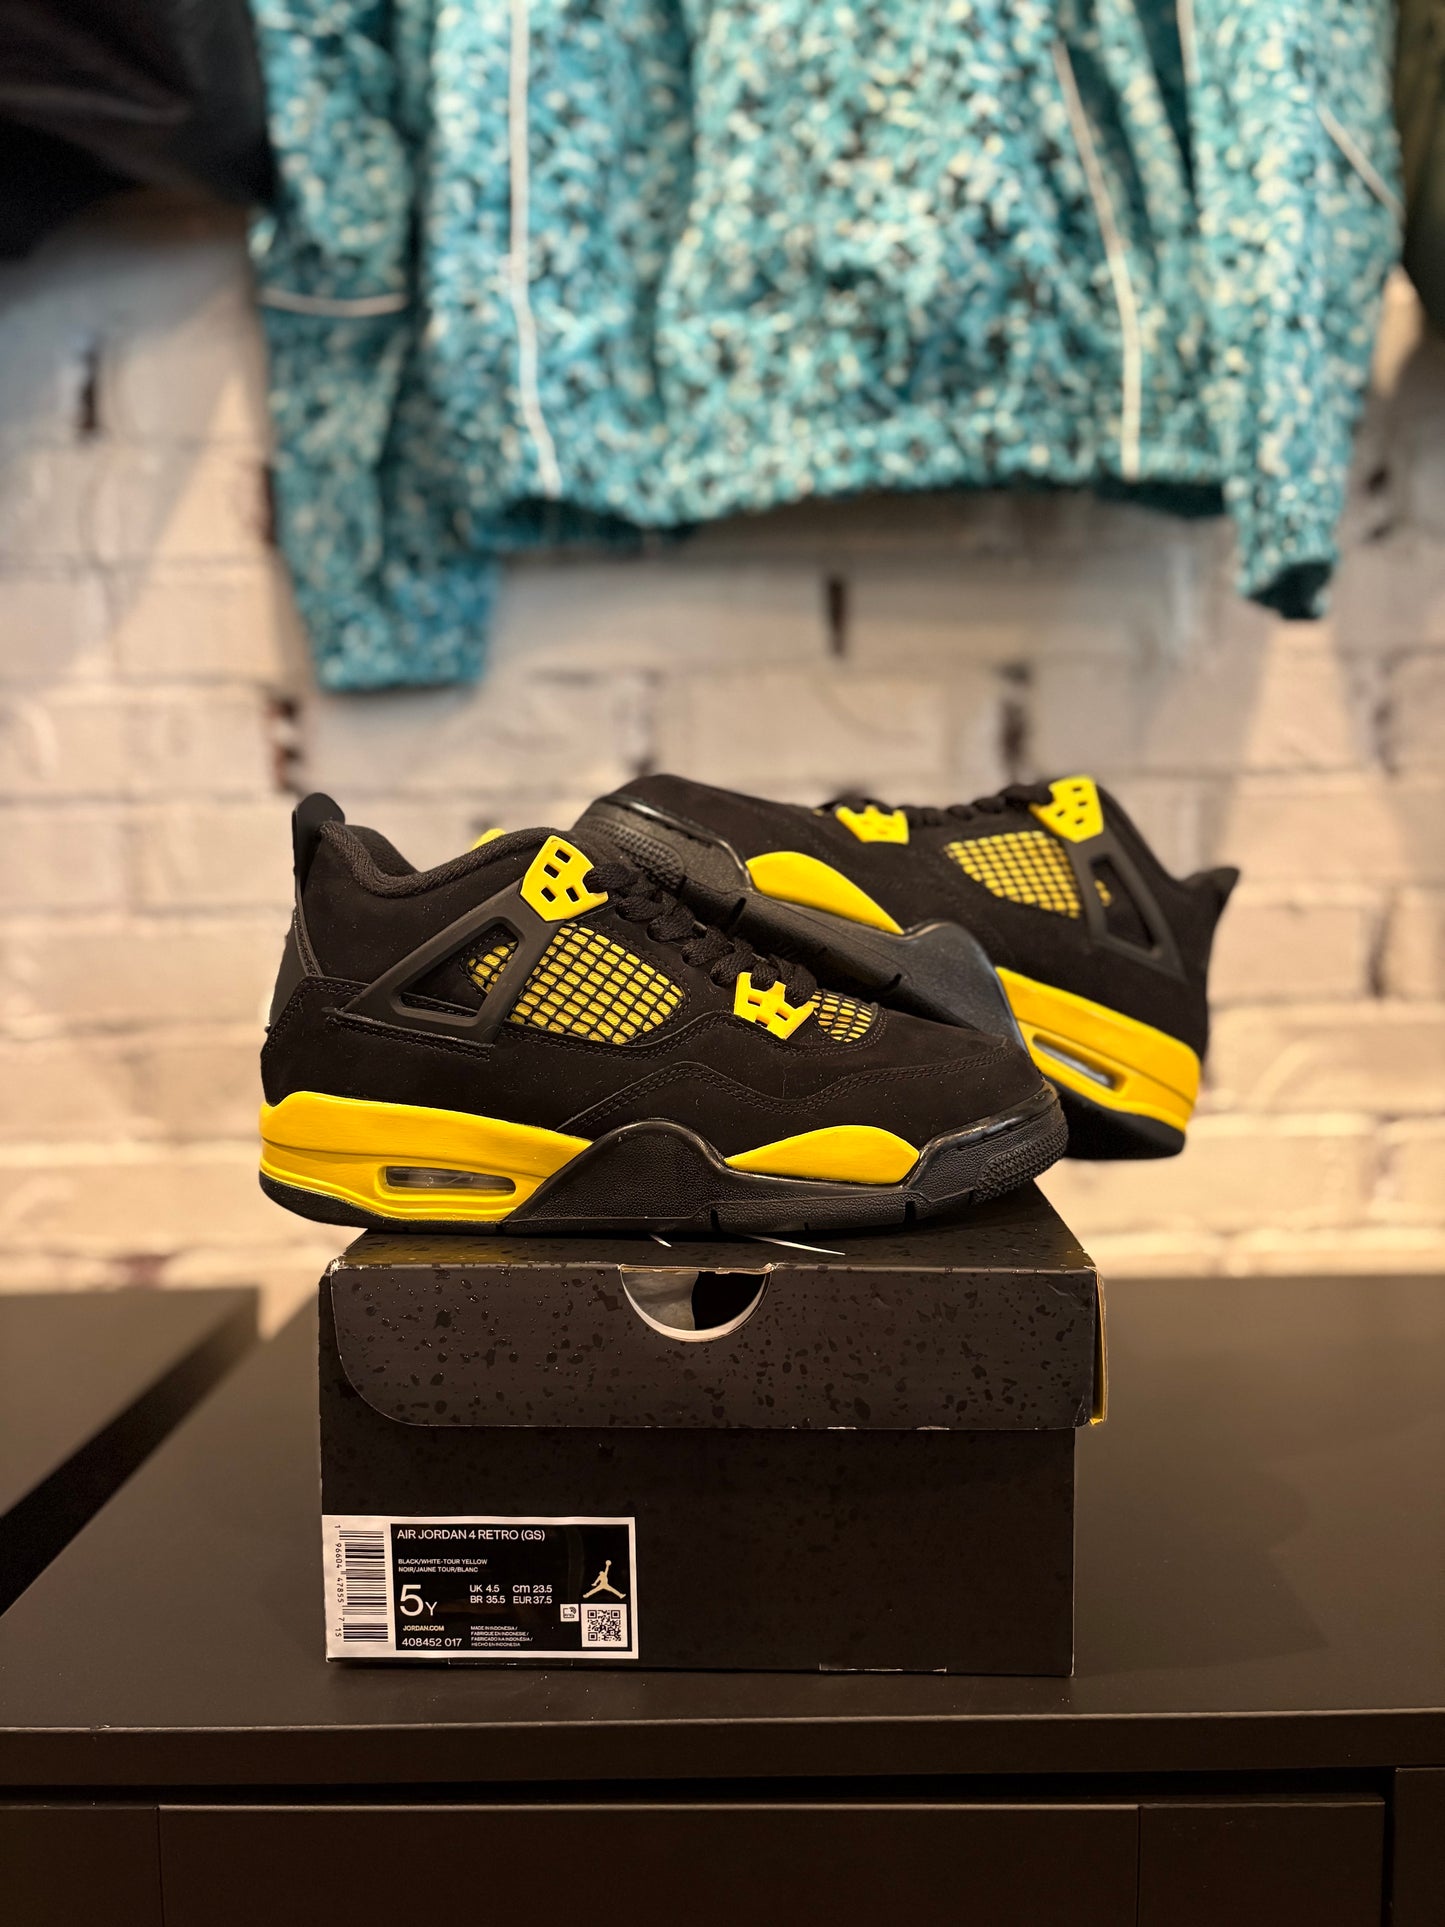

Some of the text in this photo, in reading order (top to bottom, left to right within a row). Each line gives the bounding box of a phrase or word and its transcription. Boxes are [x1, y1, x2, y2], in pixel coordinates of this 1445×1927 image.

[397, 1529, 546, 1541] AIR JORDAN 4 RETRO (GS)
[335, 1542, 343, 1569] 96604
[336, 1577, 345, 1603] 47855
[469, 1584, 500, 1593] UK 4.5
[532, 1584, 553, 1593] 23.5
[470, 1595, 506, 1604] BR 35.5
[512, 1595, 553, 1604] EUR 37.5
[335, 1627, 342, 1637] 15
[401, 1638, 462, 1647] 408452 017
